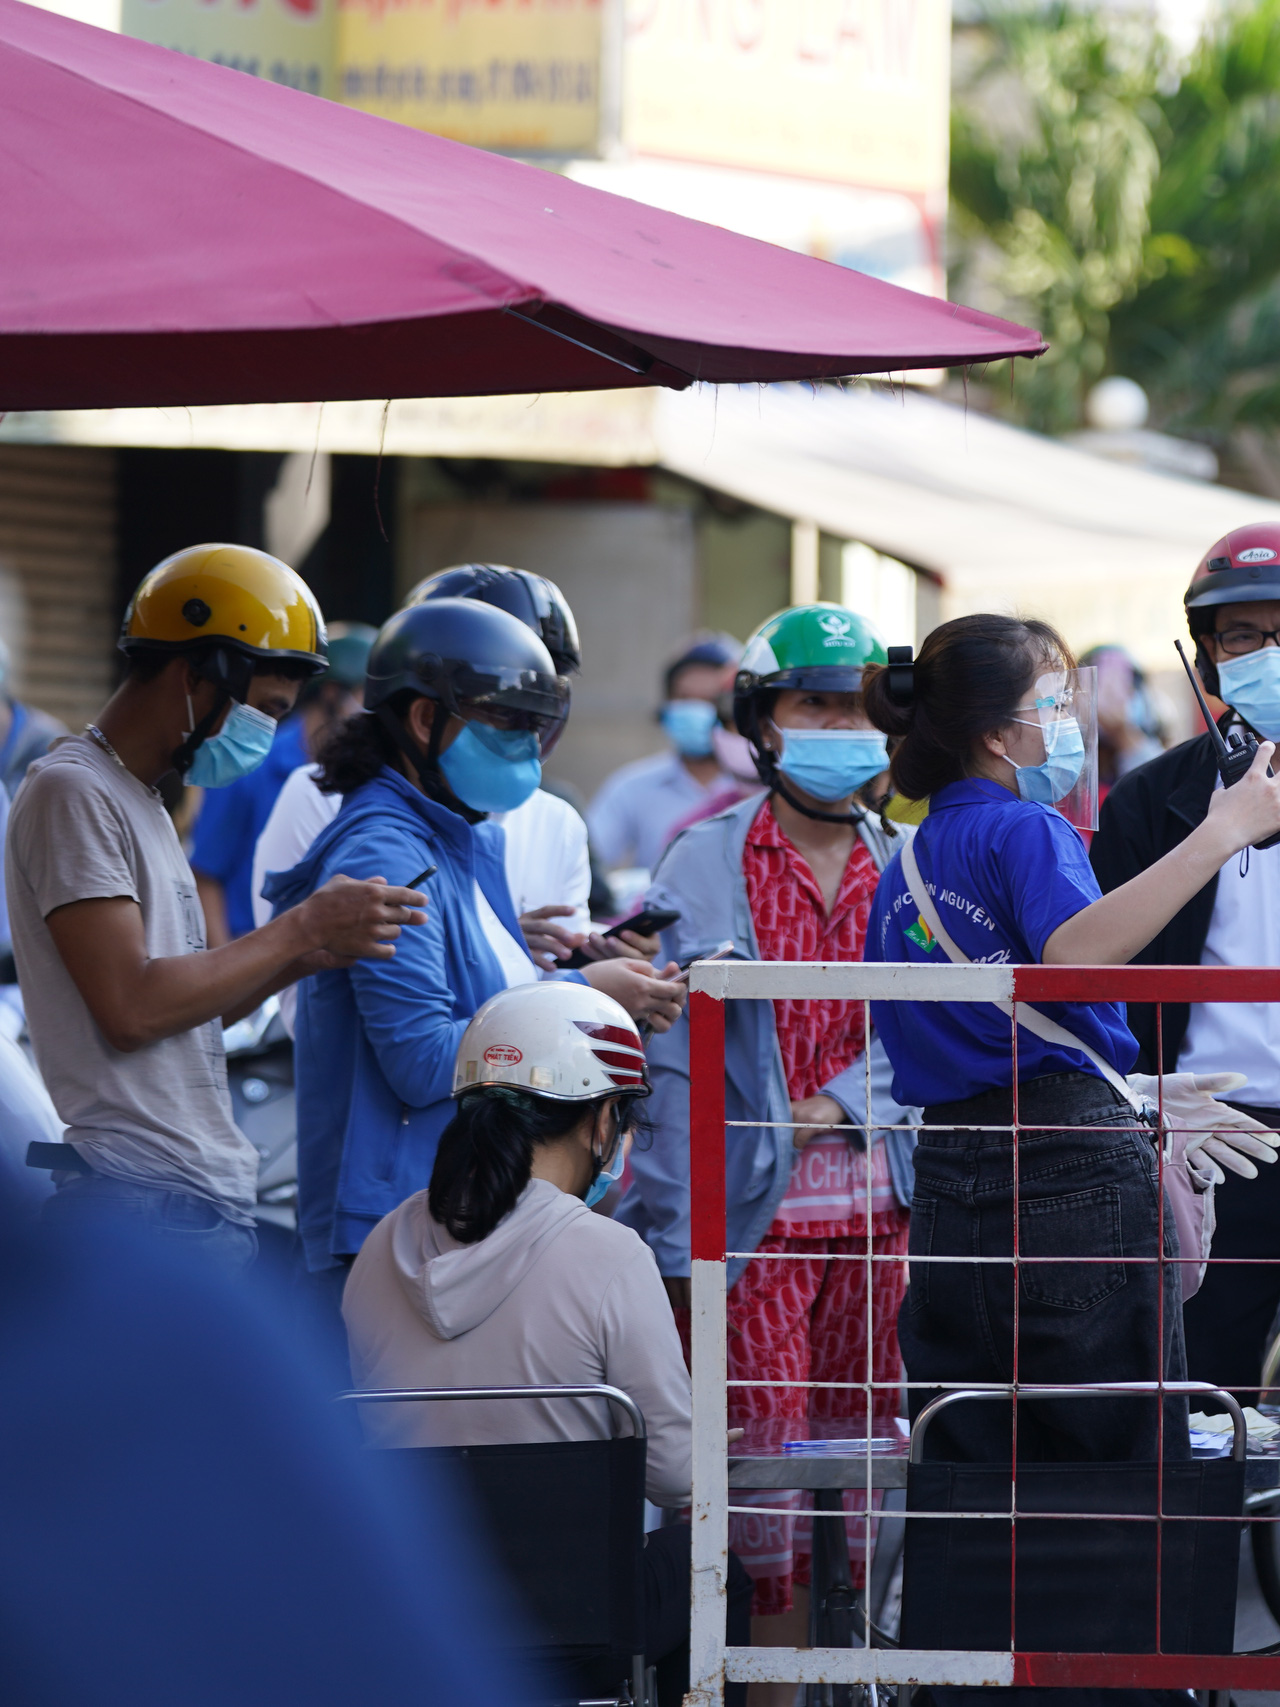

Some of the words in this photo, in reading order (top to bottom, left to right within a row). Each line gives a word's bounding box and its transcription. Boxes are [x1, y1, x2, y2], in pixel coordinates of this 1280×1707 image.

[1242, 551, 1270, 560] Asia
[1228, 749, 1247, 761] KENWOOD
[939, 888, 996, 932] NGUYỆN
